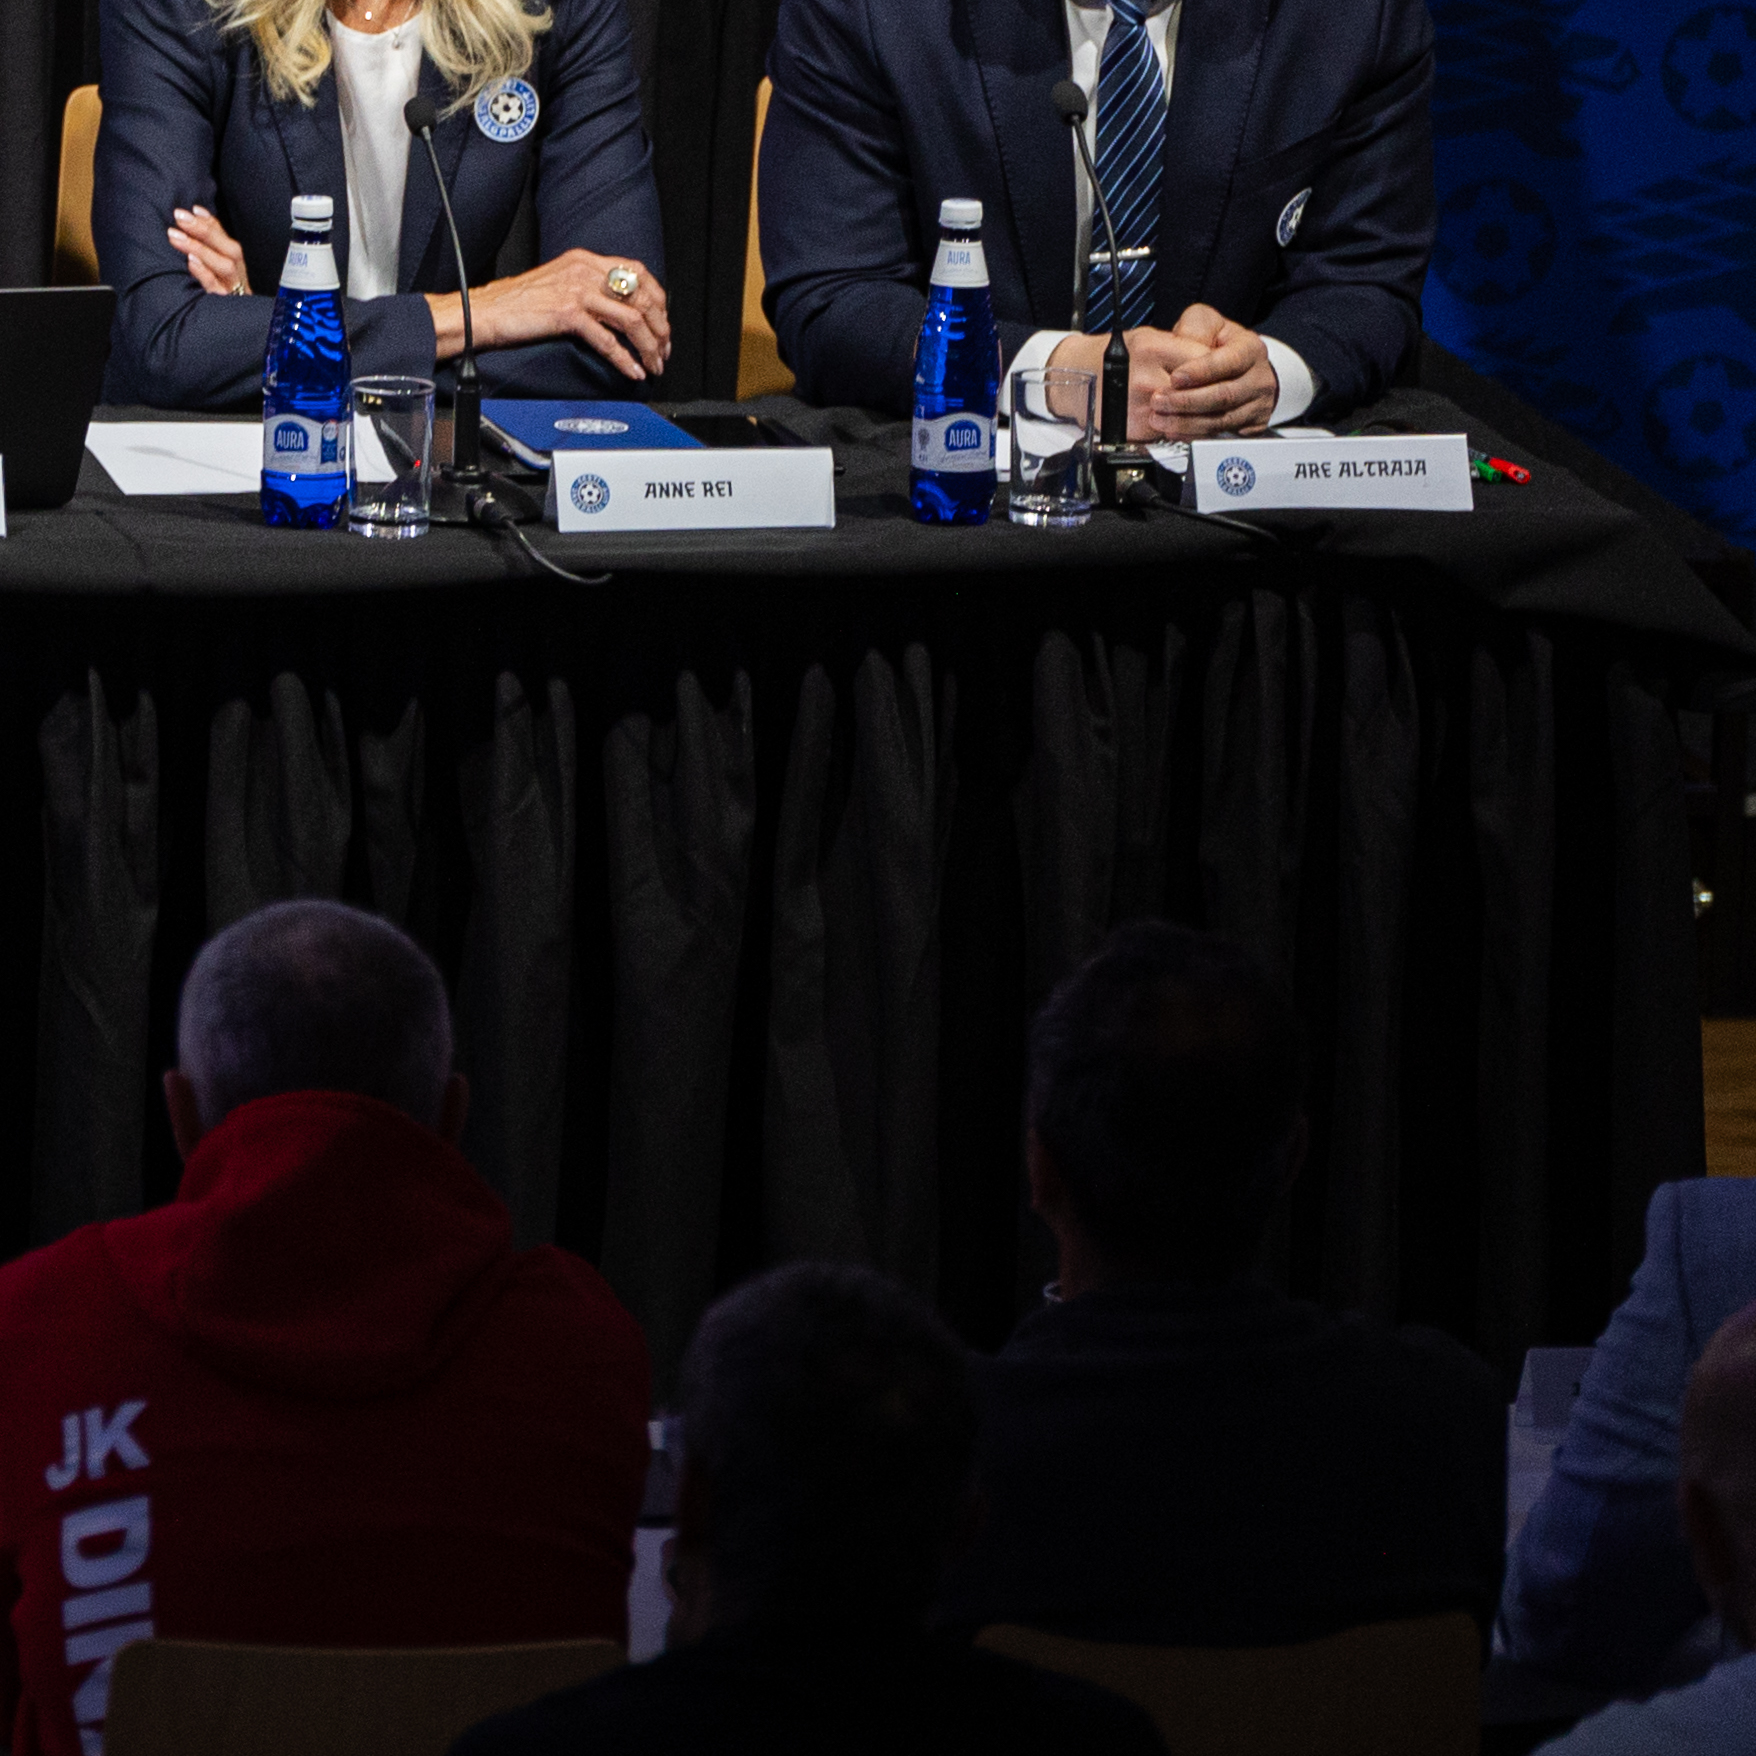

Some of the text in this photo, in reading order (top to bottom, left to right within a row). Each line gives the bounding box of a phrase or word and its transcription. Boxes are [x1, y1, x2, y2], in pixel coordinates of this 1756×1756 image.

[947, 251, 970, 265] AURA
[277, 430, 304, 449] AURA
[949, 429, 978, 447] AURA
[1294, 459, 1427, 480] ARE ALTRAJA
[644, 480, 734, 498] ANNE REI
[44, 1398, 152, 1493] JK
[60, 1493, 156, 1756] DIN
